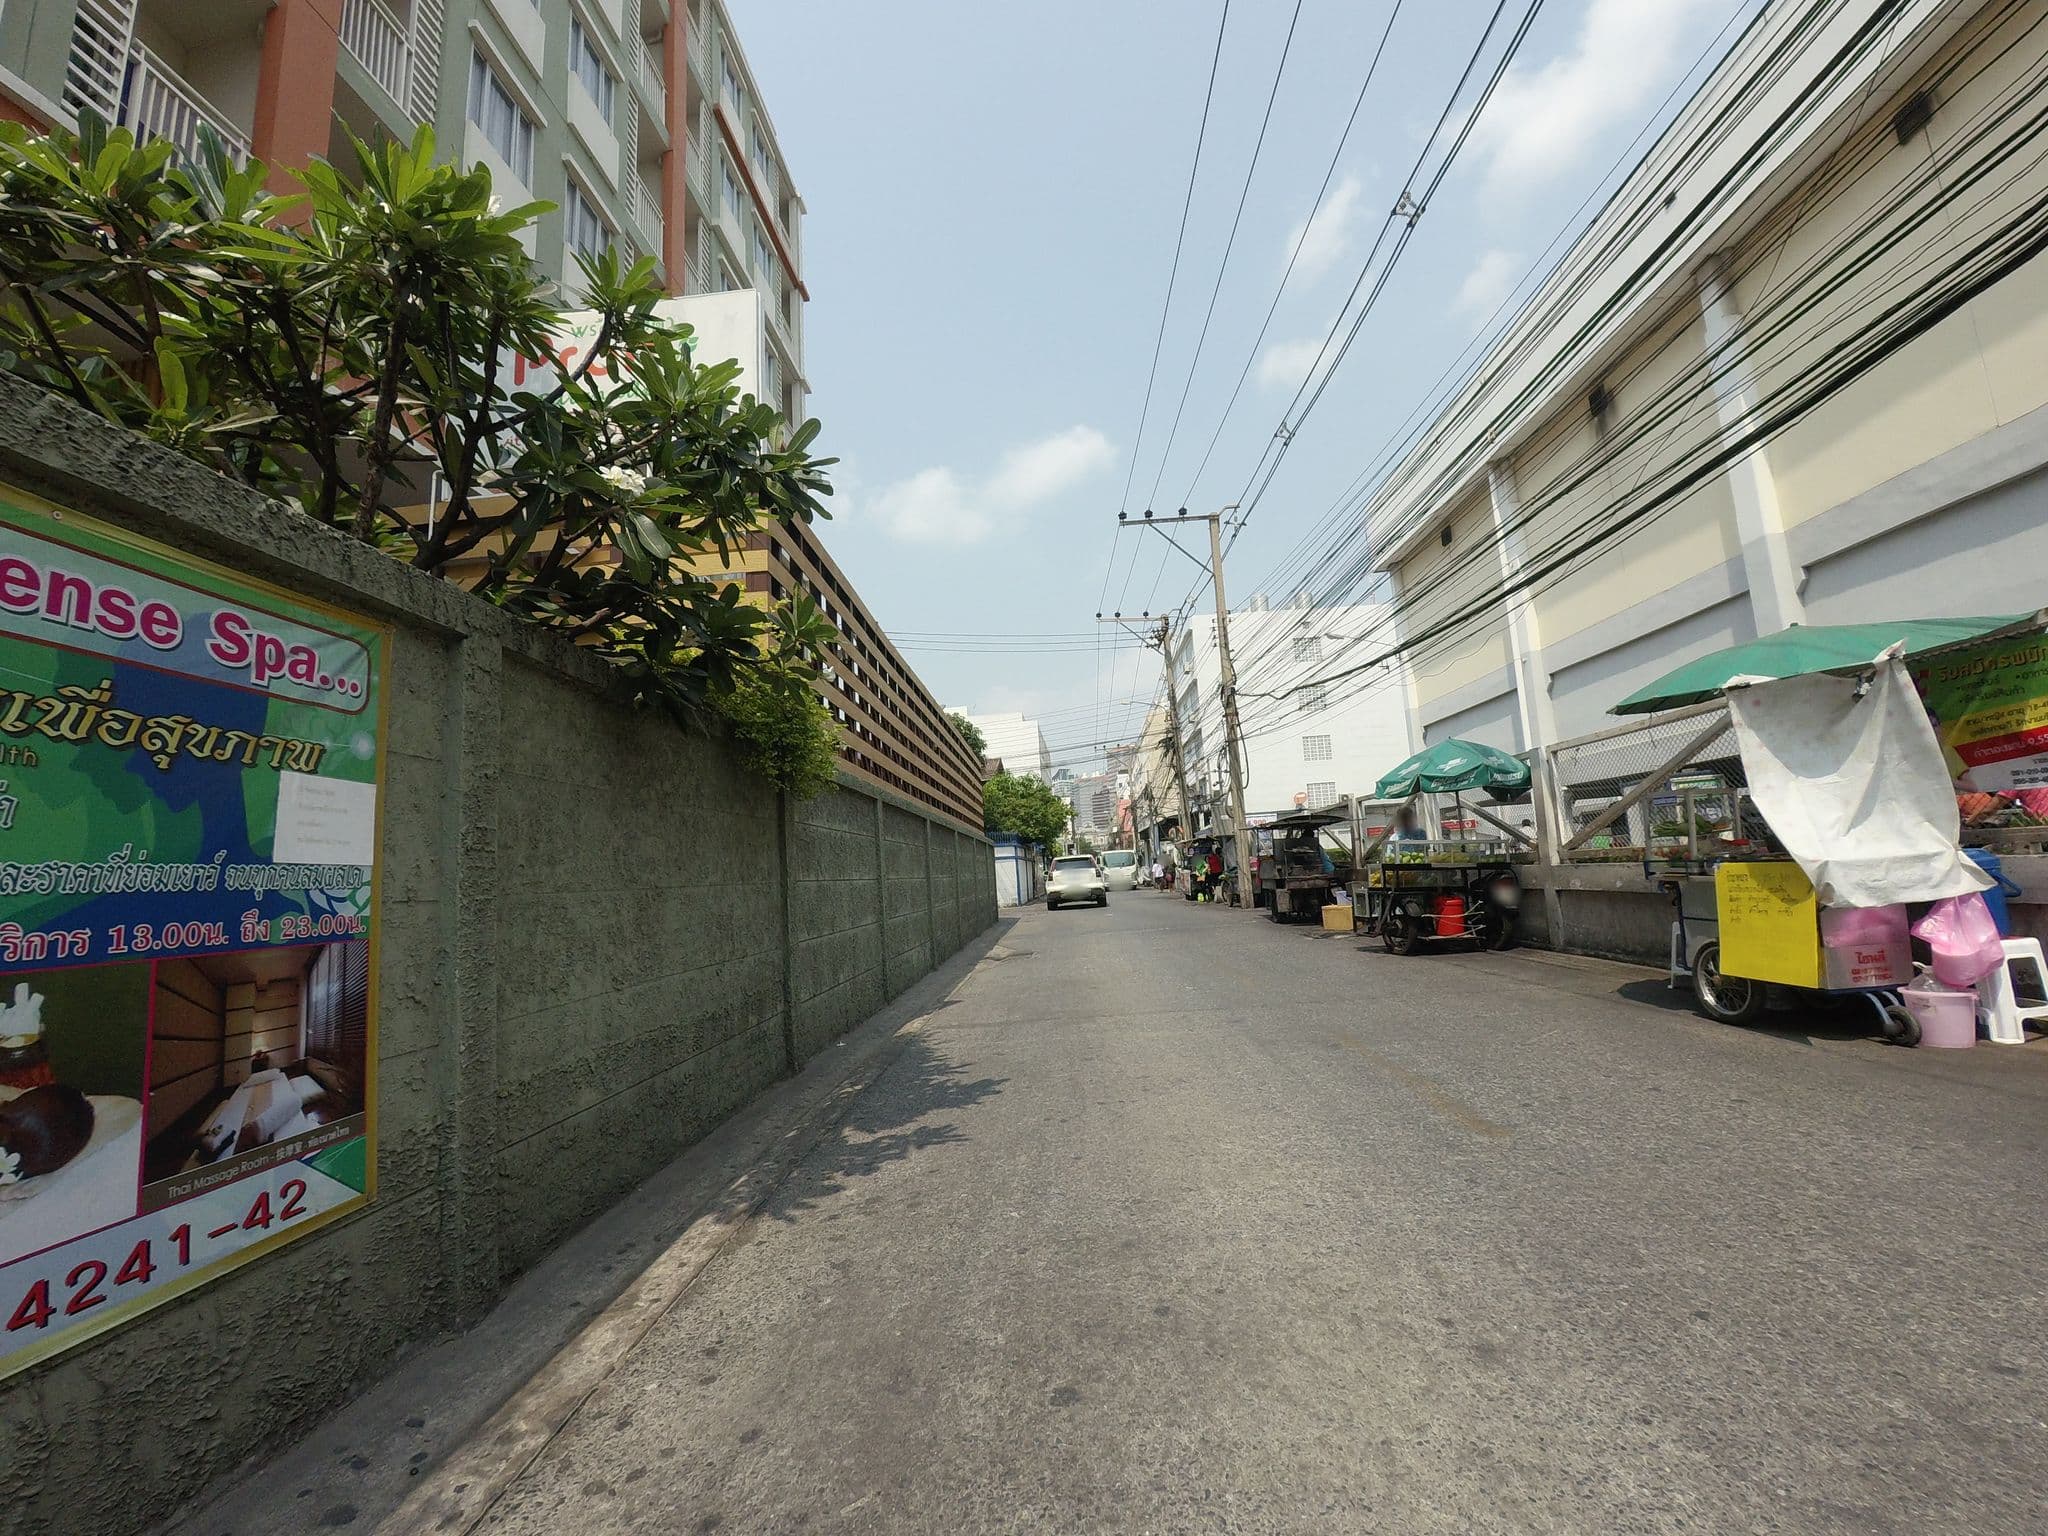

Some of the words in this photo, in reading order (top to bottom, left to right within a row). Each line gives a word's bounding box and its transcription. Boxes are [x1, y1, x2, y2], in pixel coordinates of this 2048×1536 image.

[0, 556, 181, 648] ense
[207, 610, 360, 695] Spa...
[0, 680, 324, 773] เพื่อสุขภาพ
[241, 908, 270, 943] ถึง
[167, 1179, 192, 1199] Thai
[193, 1165, 240, 1191] Massage
[241, 1154, 270, 1172] Room
[5, 1179, 307, 1332] 4241-42
